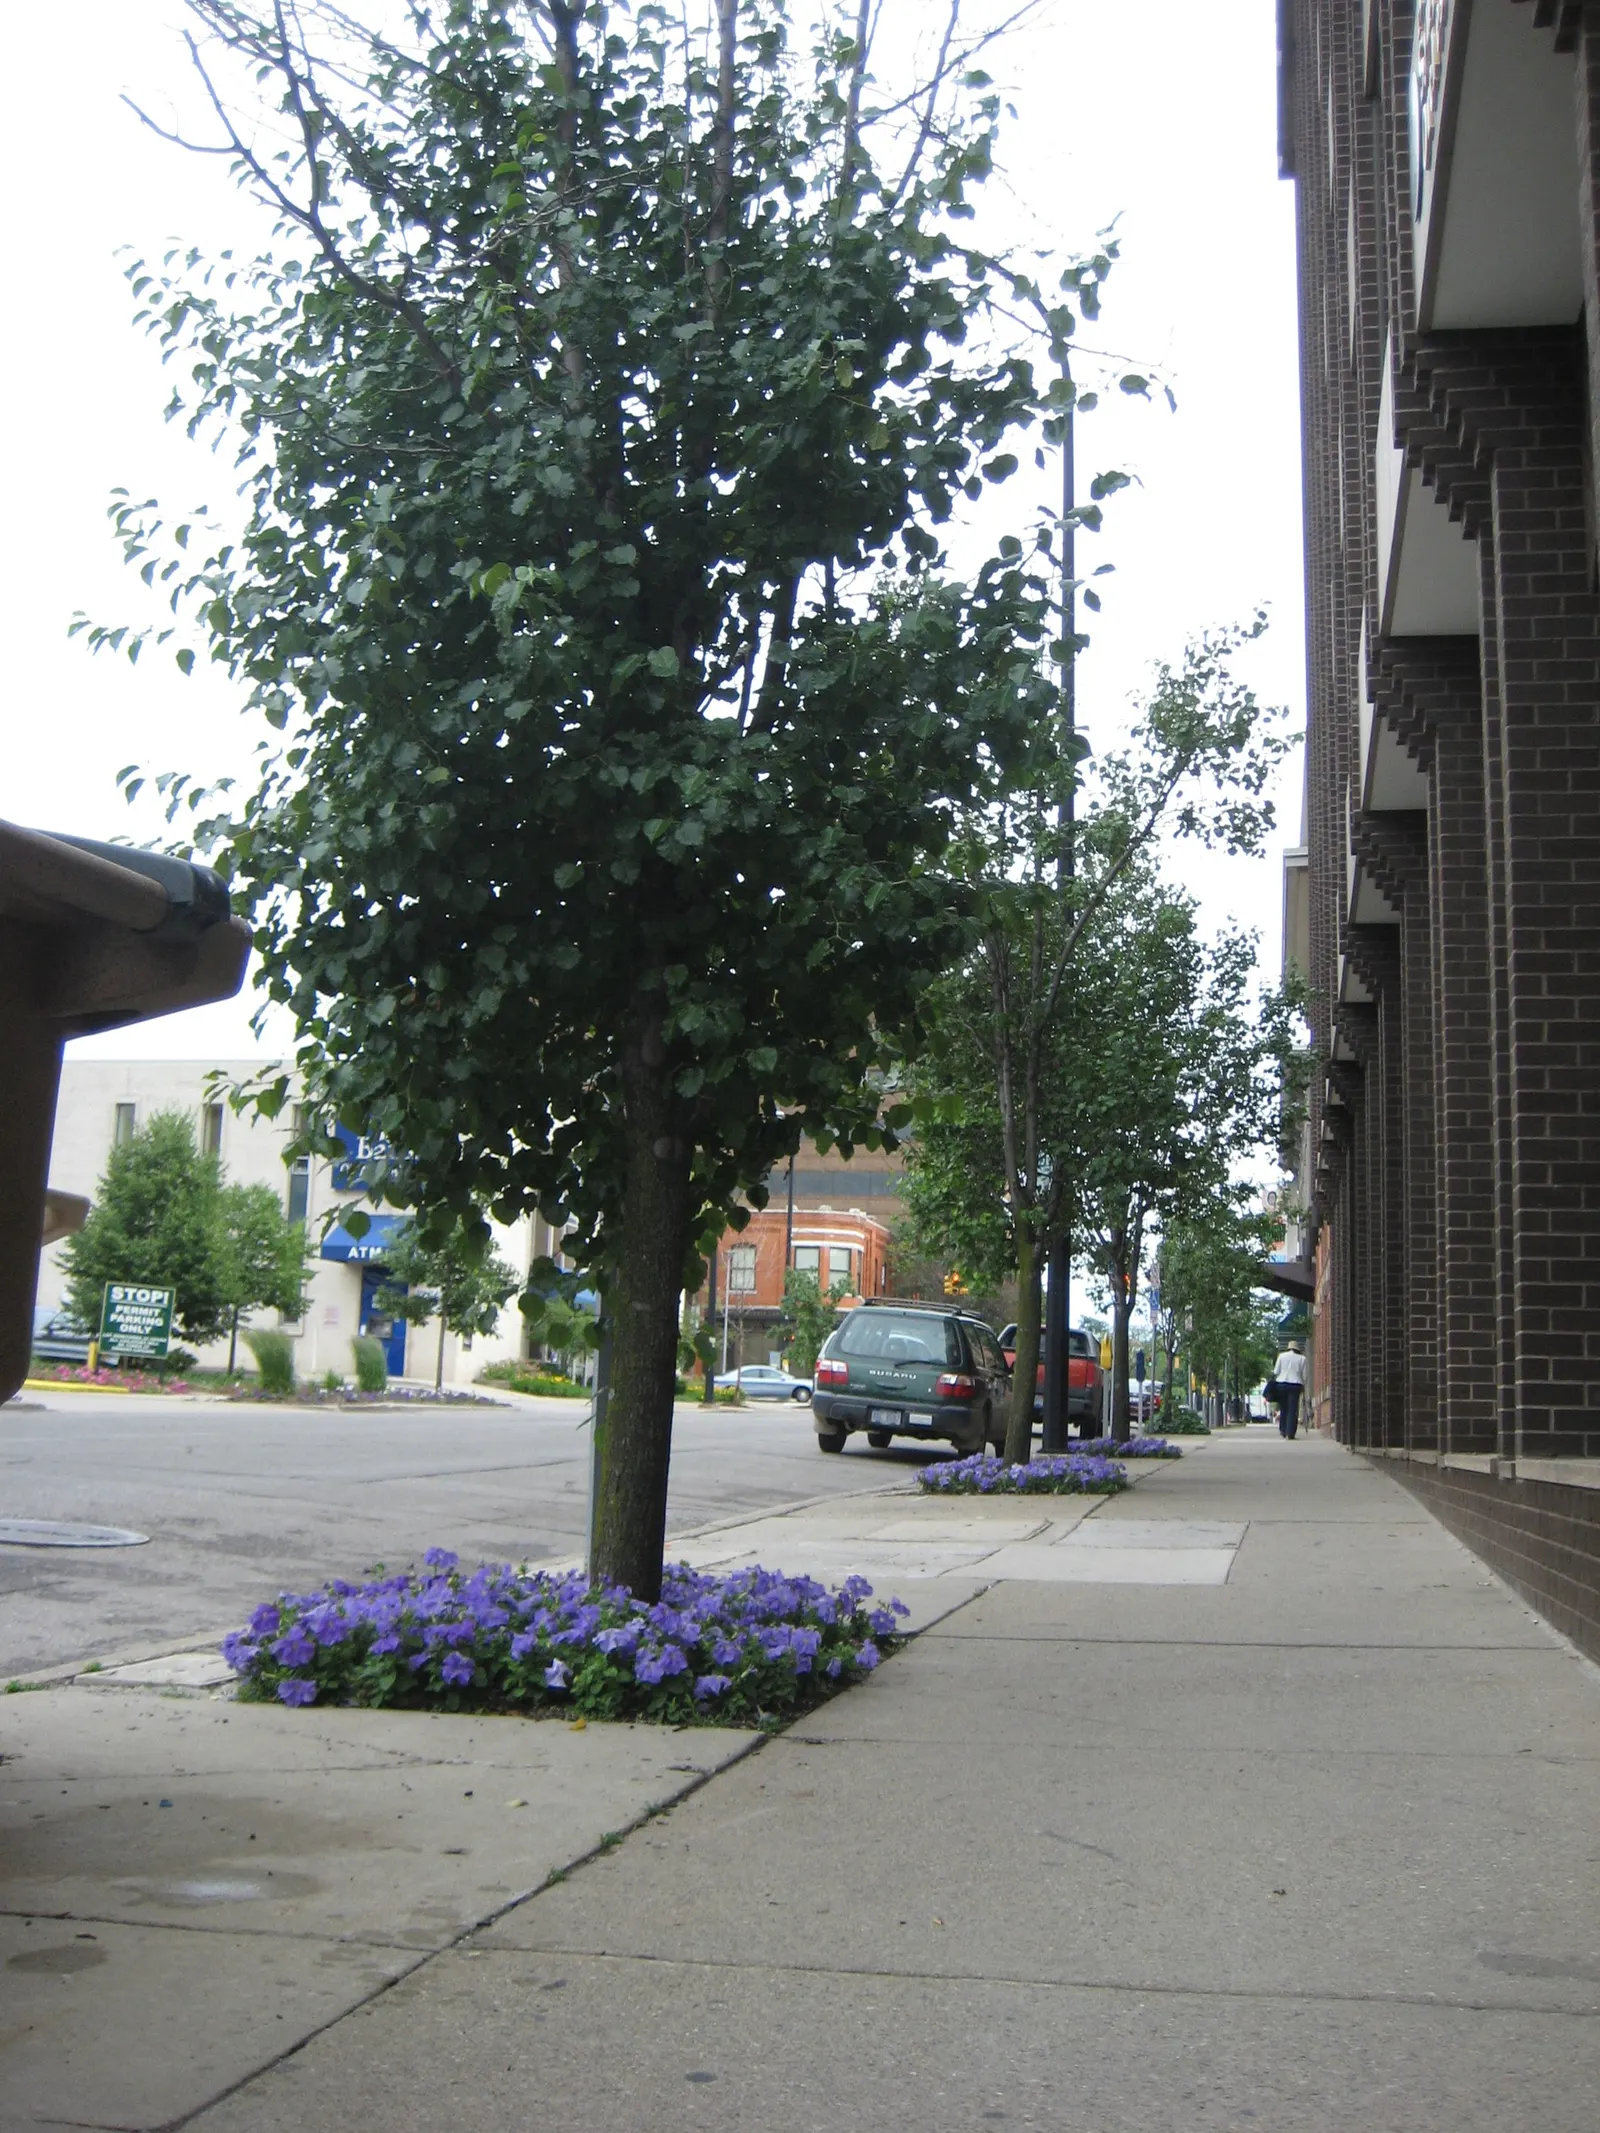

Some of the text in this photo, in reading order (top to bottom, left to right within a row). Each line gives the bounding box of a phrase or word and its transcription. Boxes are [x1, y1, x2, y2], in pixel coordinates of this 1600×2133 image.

[111, 1286, 169, 1305] STOP!
[115, 1304, 161, 1317] PERMIT
[110, 1313, 164, 1327] PARKING
[119, 1323, 152, 1334] ONLY
[868, 1369, 917, 1380] SUBARU
